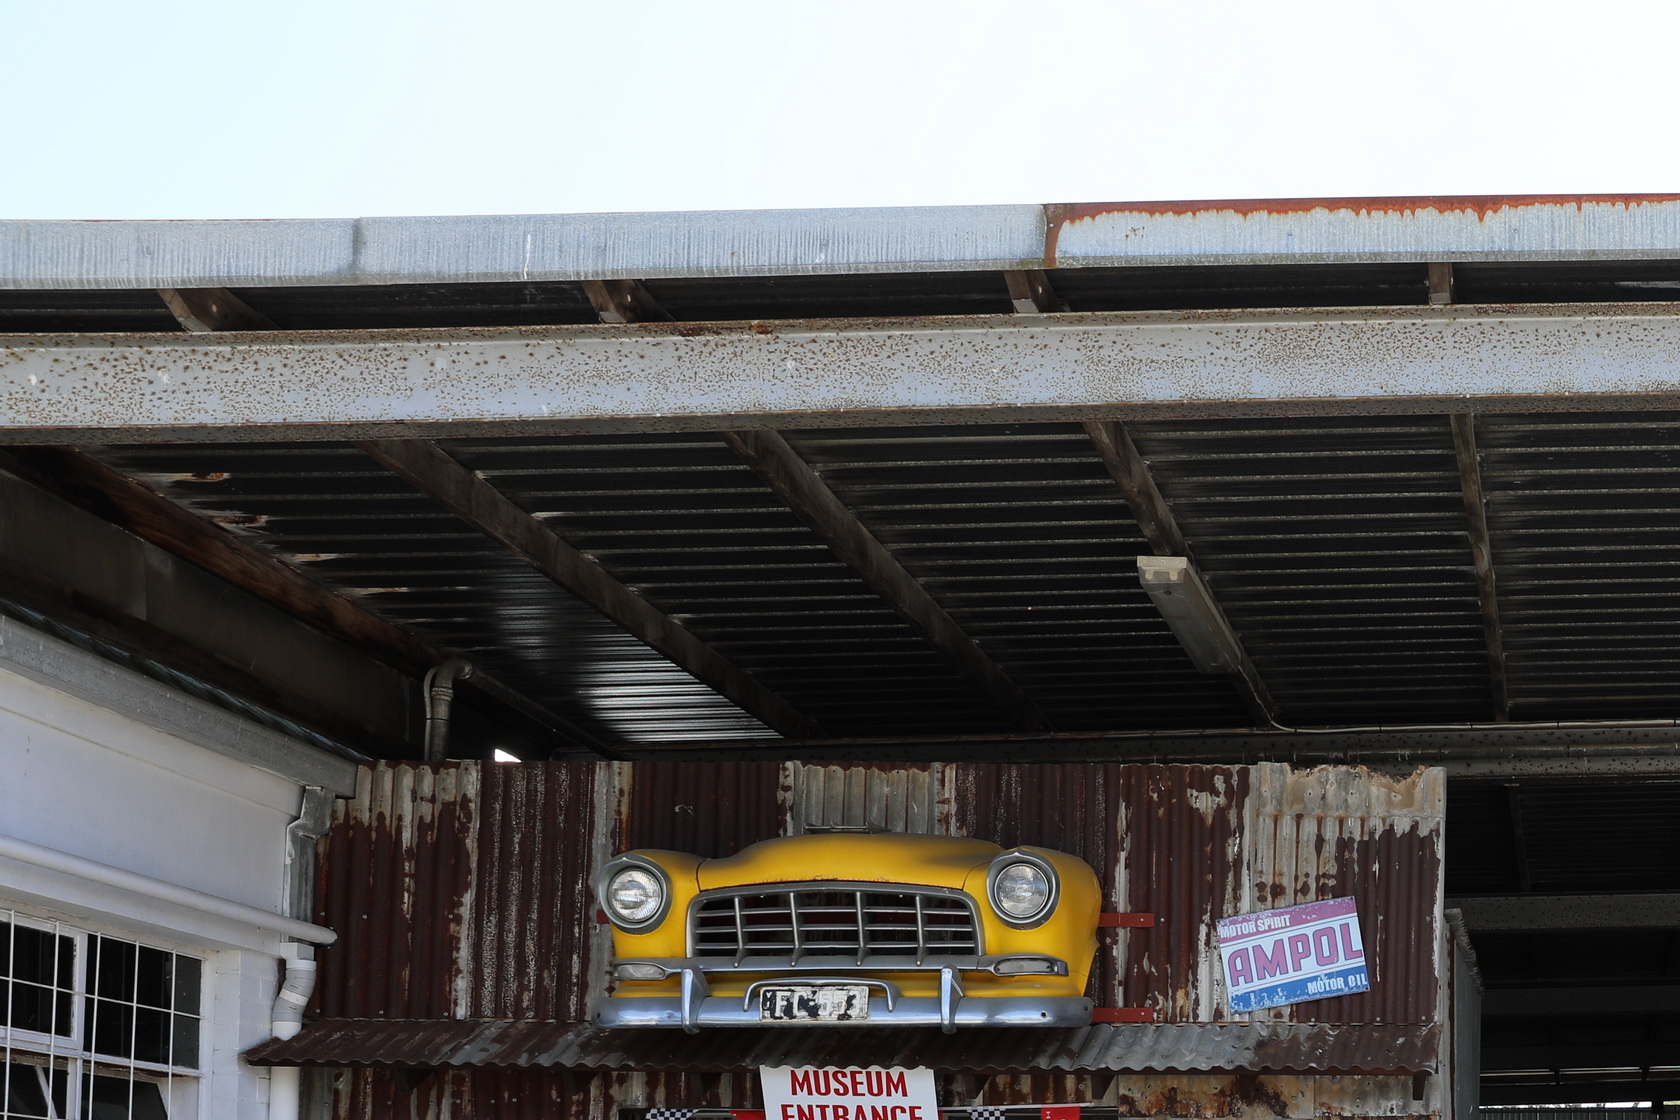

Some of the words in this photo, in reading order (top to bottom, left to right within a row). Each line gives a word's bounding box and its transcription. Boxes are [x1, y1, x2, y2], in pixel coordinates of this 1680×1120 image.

[1220, 921, 1257, 938] MOTOR
[1258, 914, 1291, 932] SPIRIT
[1228, 922, 1364, 987] AMPOL
[1307, 976, 1344, 995] MOTOR
[1347, 973, 1368, 987] OIL
[790, 1069, 908, 1097] MUSEUM
